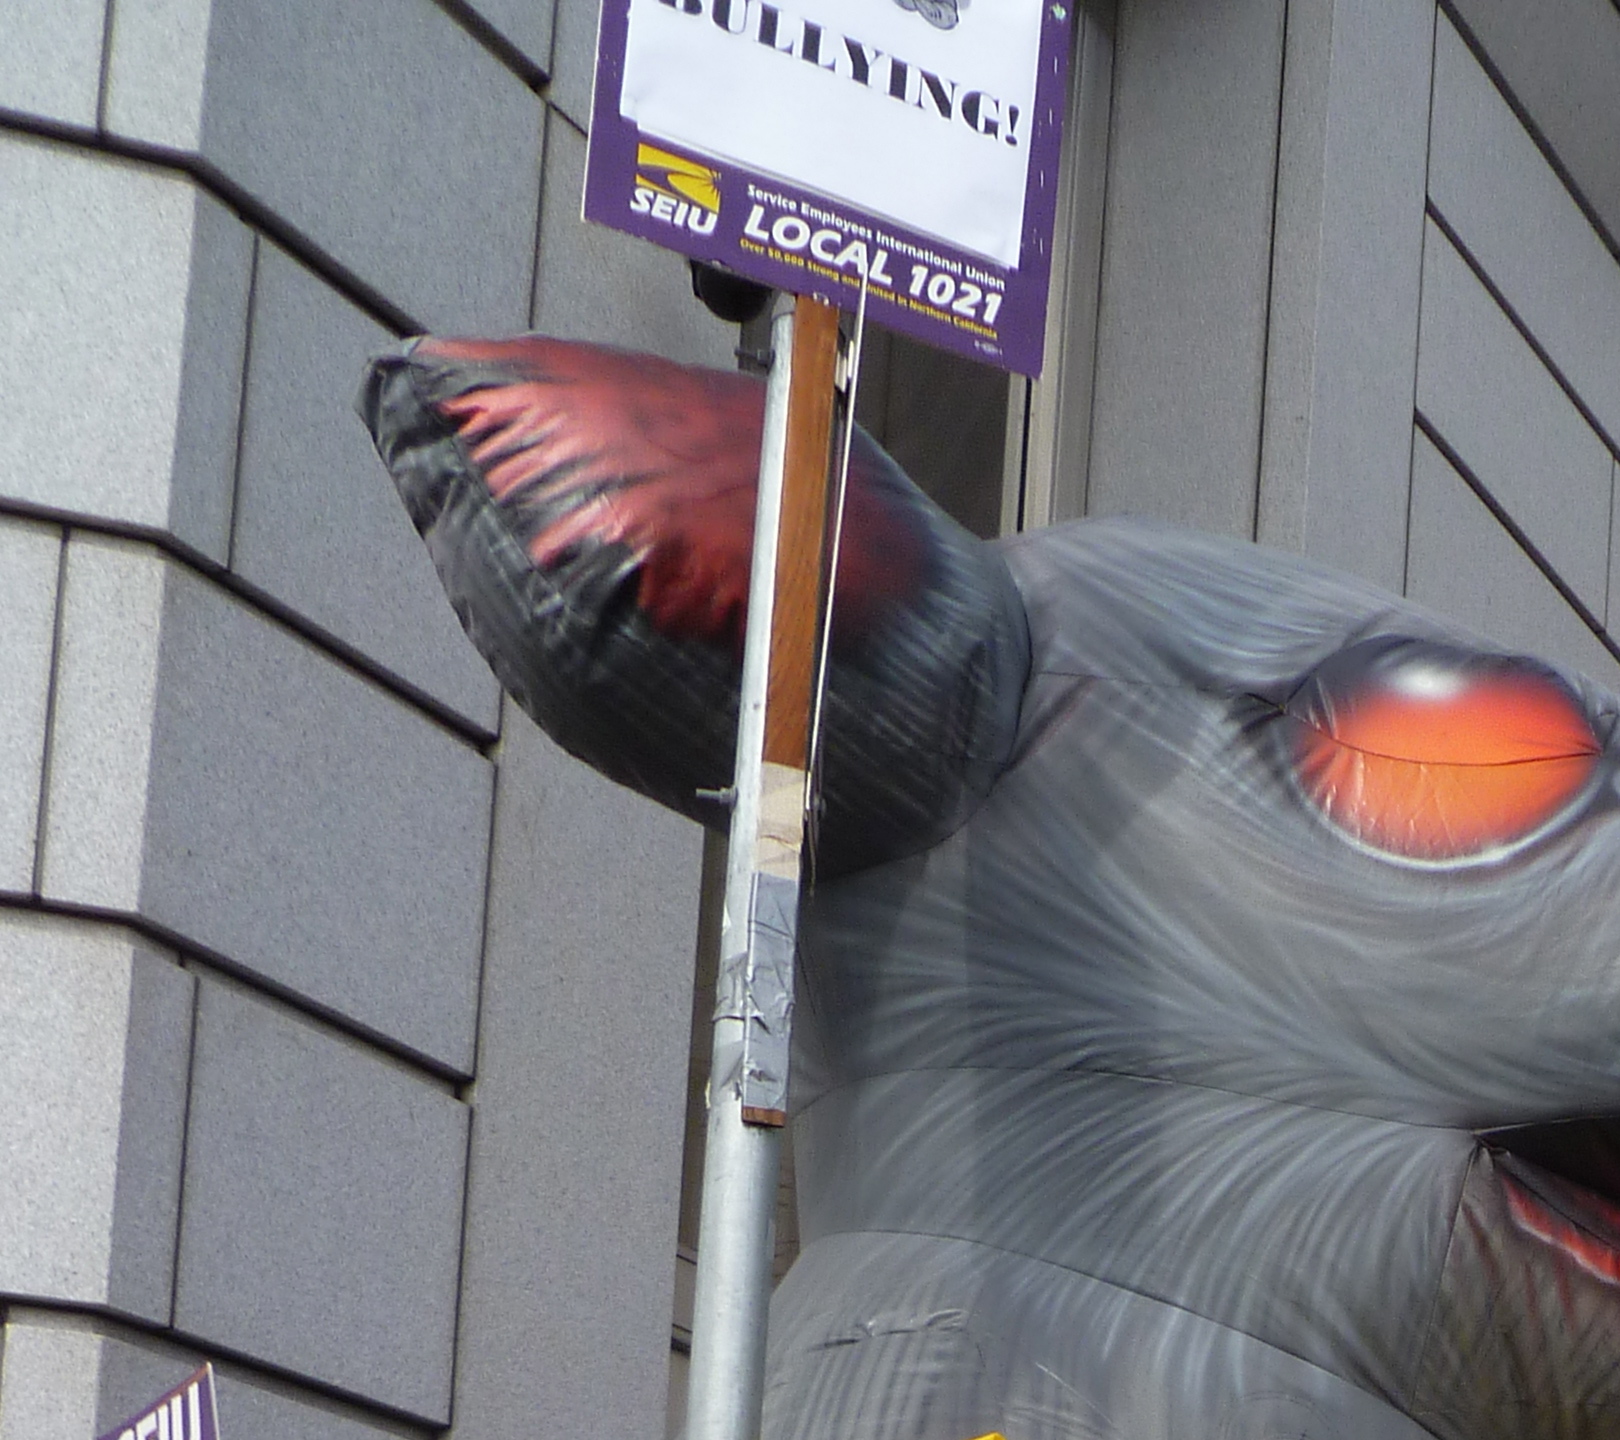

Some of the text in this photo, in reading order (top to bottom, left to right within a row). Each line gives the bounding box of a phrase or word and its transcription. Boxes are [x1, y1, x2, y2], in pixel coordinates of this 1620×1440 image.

[630, 187, 718, 236] SEIU
[740, 237, 766, 255] Over
[747, 184, 1006, 292] Service Employees International Union
[743, 204, 1003, 325] LOCAL 1021
